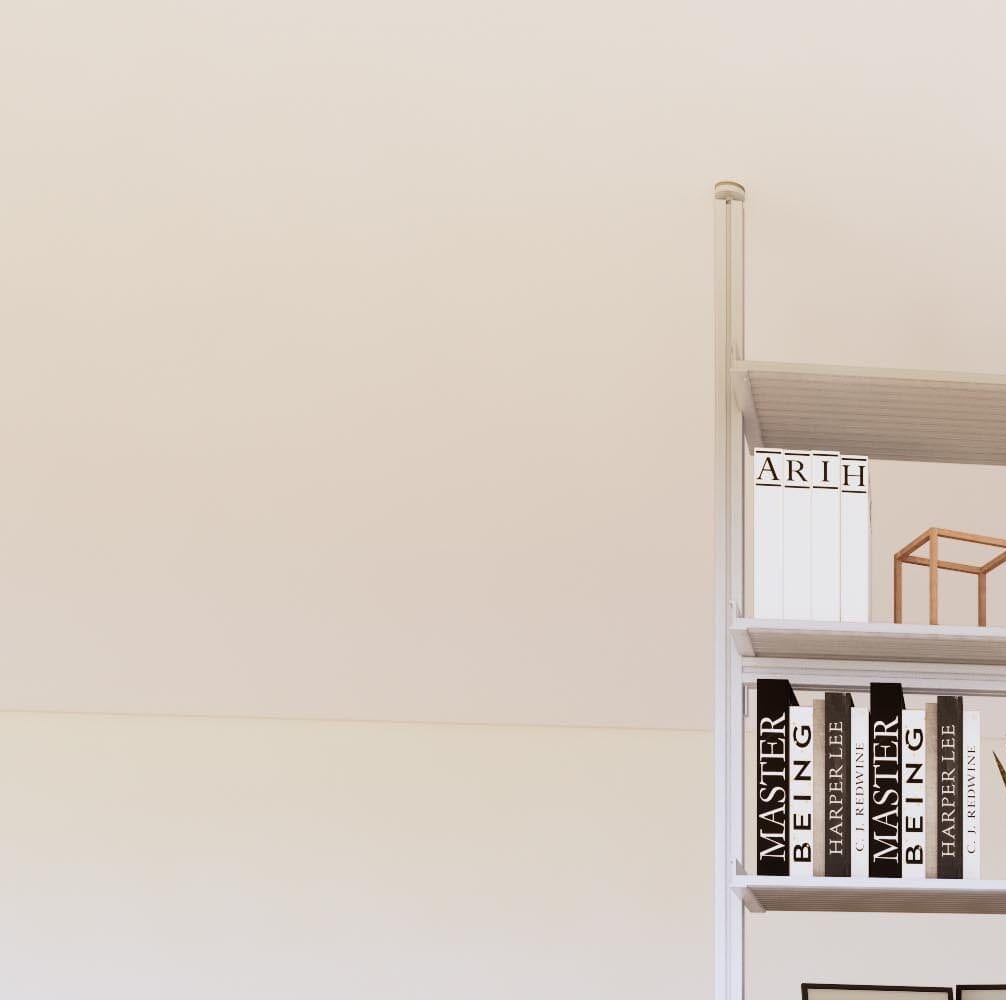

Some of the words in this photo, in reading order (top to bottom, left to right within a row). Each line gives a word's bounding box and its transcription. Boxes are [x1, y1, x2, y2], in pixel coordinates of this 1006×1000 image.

[829, 721, 843, 759] LEE
[855, 743, 864, 817] REDWINE
[941, 724, 956, 762] LEE
[967, 745, 976, 819] REDWINE
[758, 711, 786, 862] MASTER
[793, 725, 812, 862] BEING
[829, 766, 843, 856] HARPER
[872, 715, 899, 863] MASTER
[905, 728, 924, 865] BEING
[941, 767, 956, 857] HARPER
